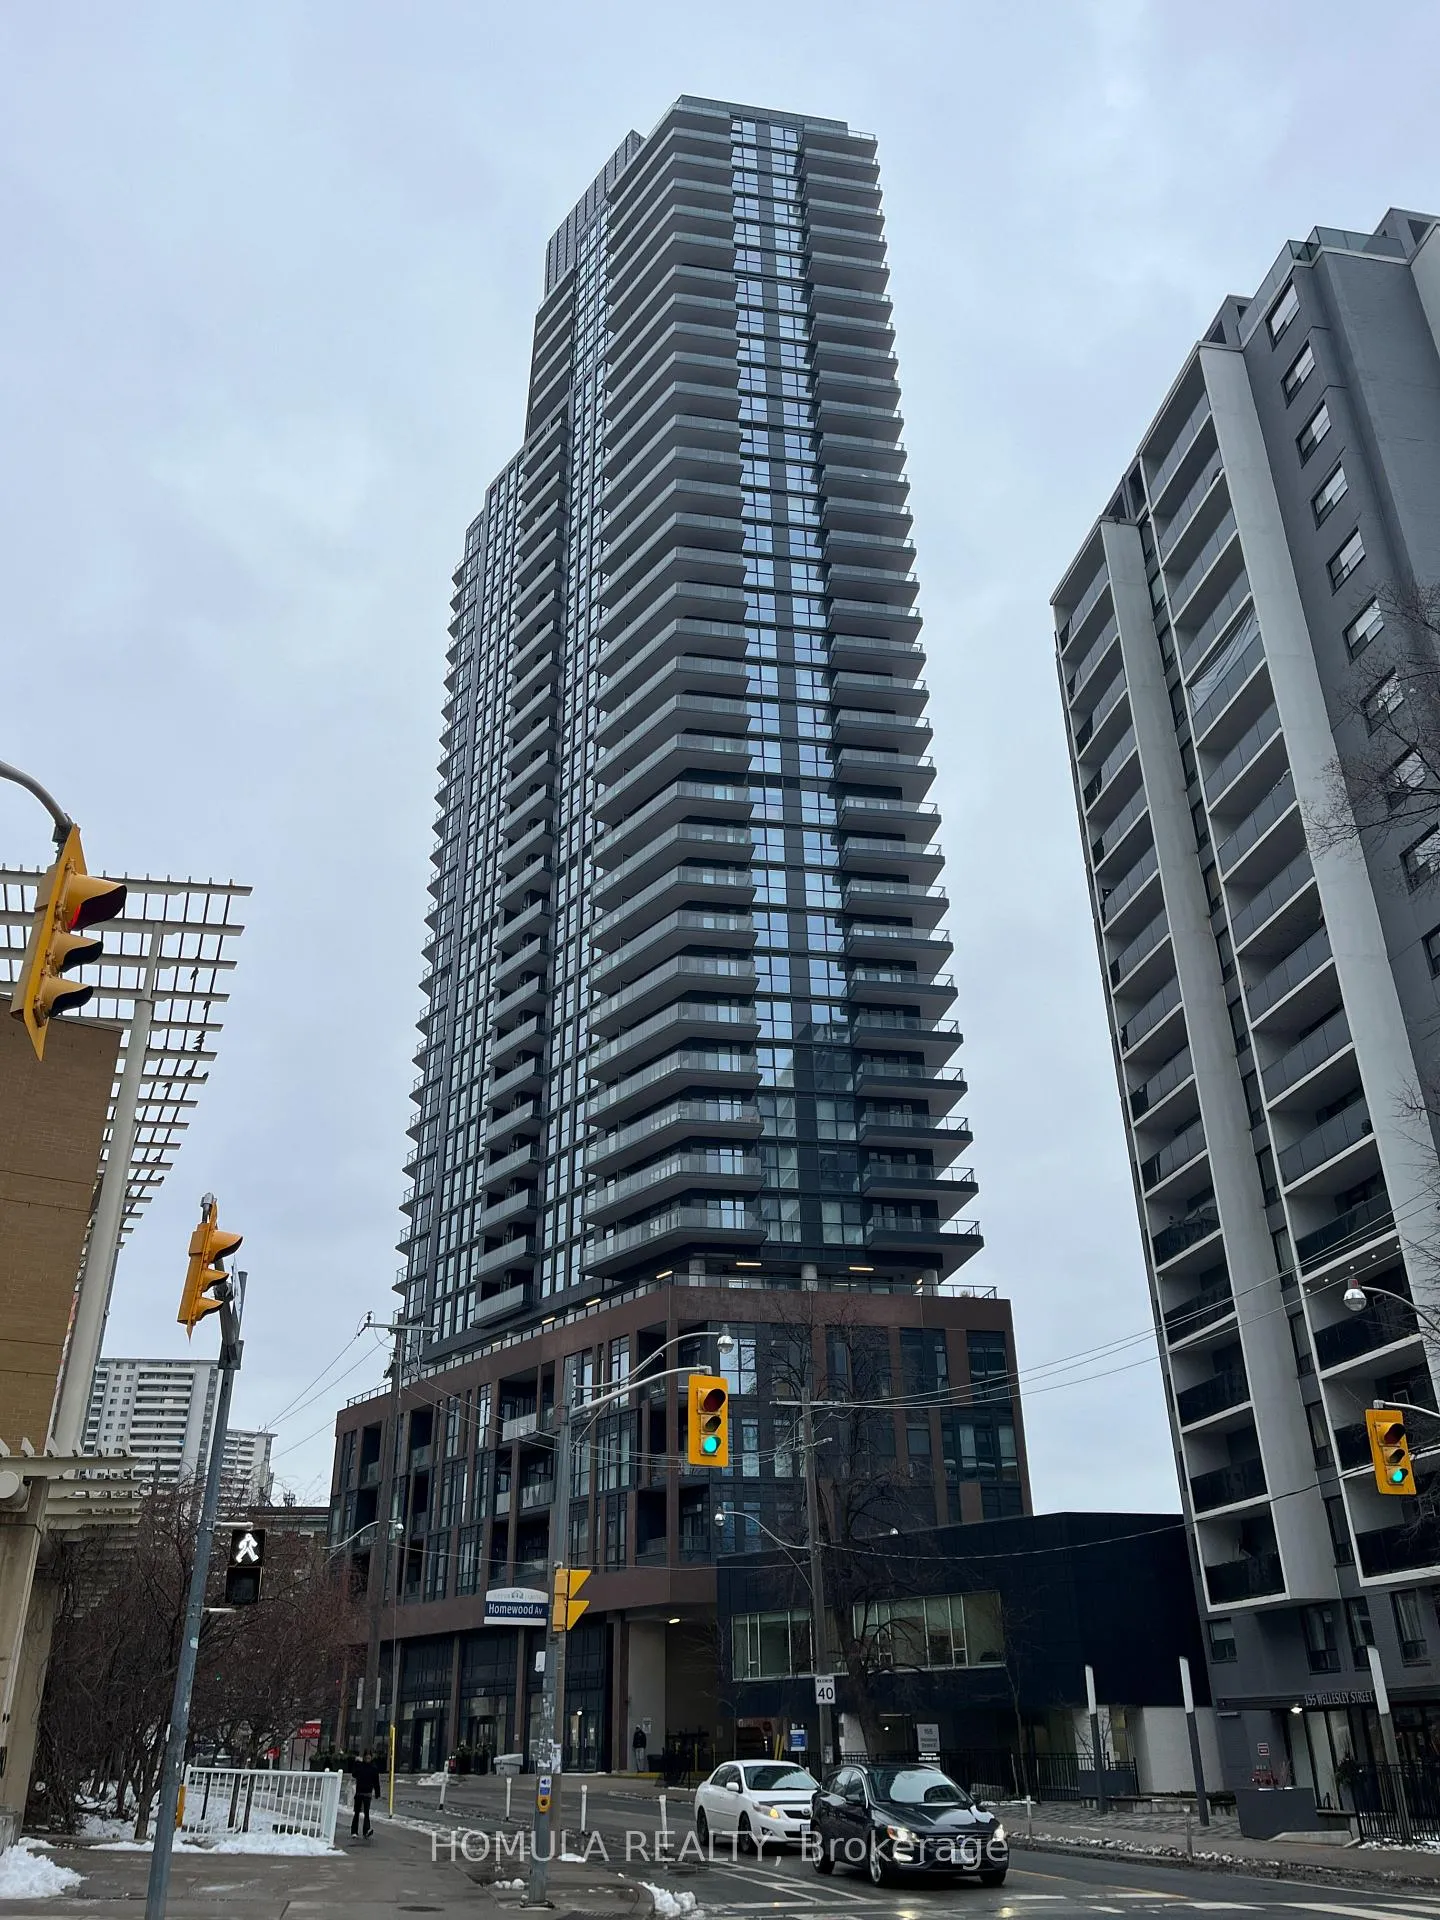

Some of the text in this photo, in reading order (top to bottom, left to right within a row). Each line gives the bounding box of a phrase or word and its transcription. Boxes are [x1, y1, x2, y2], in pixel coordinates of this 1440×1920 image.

[488, 1603, 543, 1615] Homewood Av
[818, 1687, 834, 1700] 40
[1305, 1690, 1374, 1706] 155 WELLESLEY STREET
